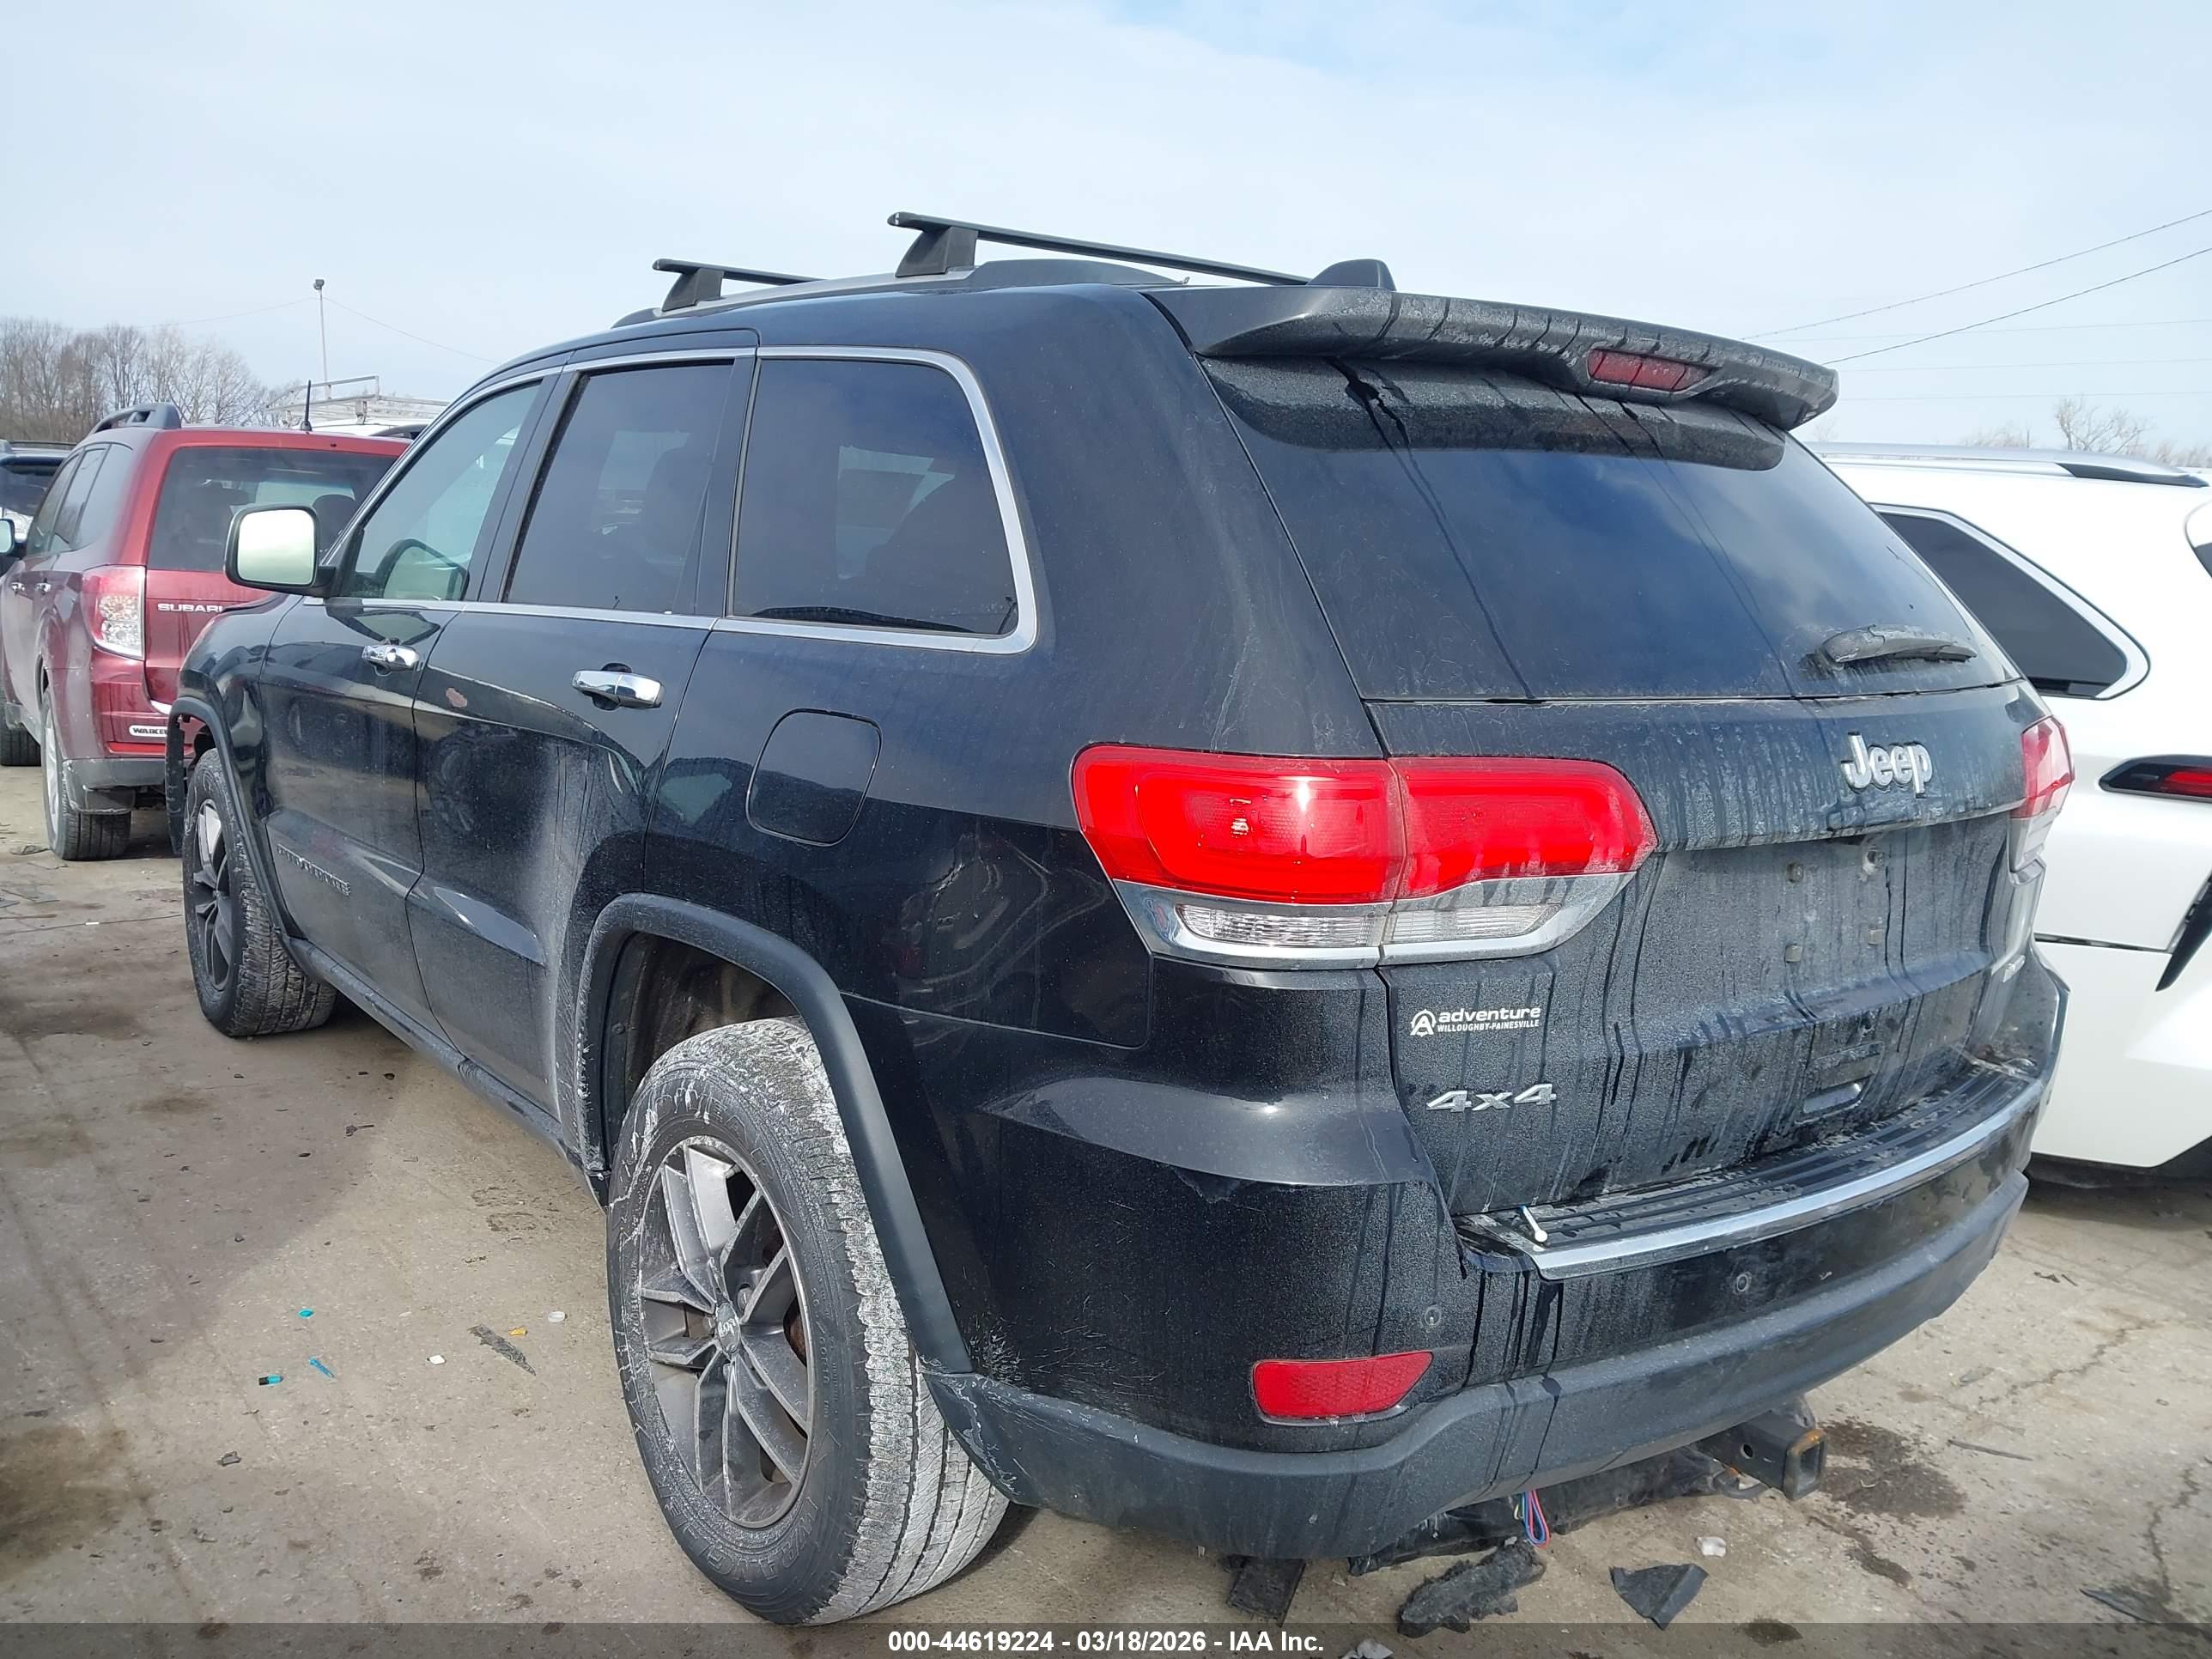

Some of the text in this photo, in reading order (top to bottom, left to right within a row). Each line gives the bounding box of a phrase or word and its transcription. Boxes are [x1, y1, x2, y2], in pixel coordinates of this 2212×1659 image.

[1840, 730, 1933, 799] Jeep
[1437, 1019, 1540, 1032] WILLOUGHBY-PAINESVILLE
[1438, 1007, 1541, 1023] adventure
[1425, 1083, 1557, 1112] 4x4
